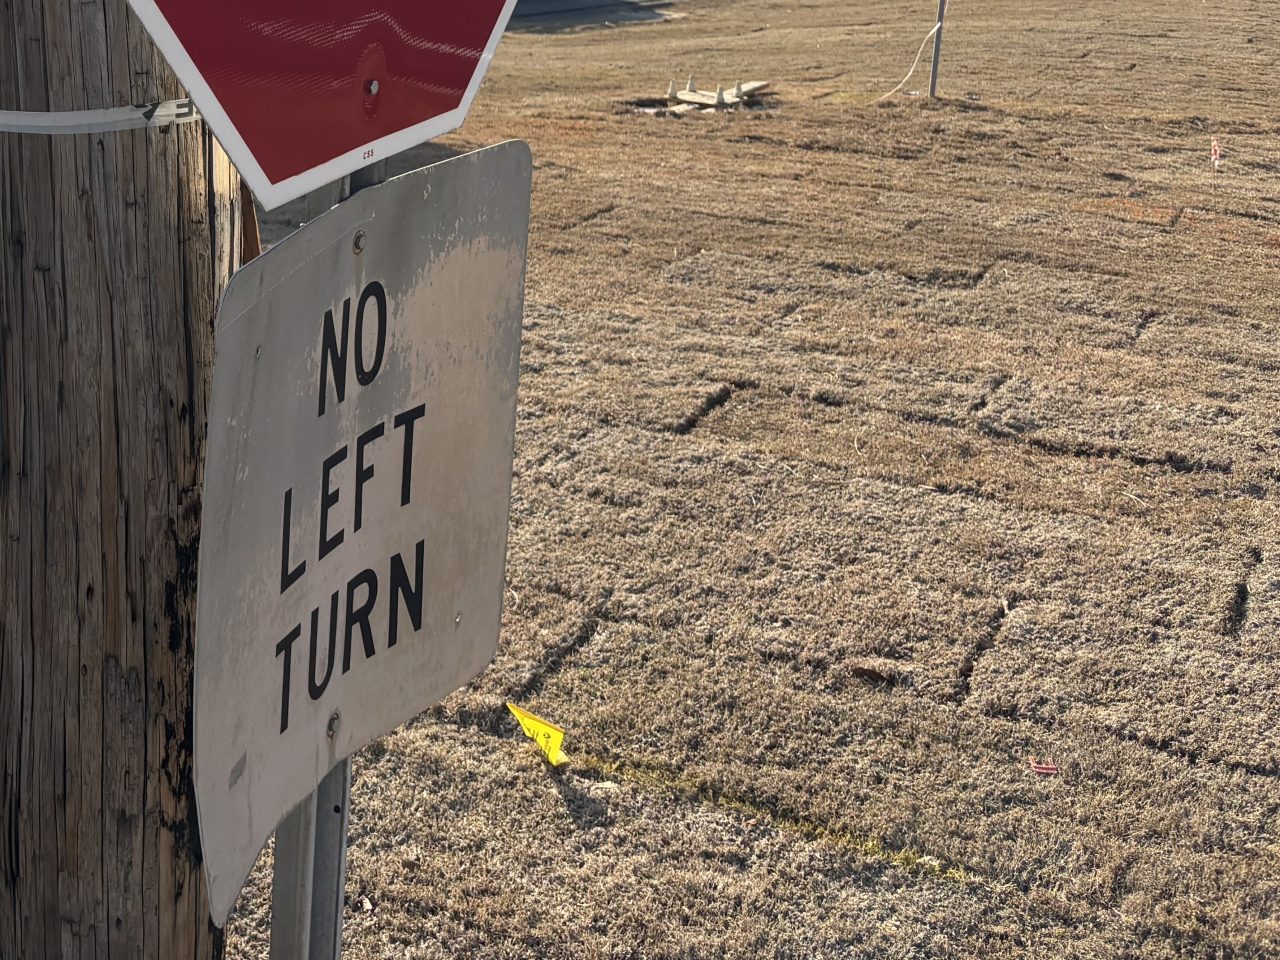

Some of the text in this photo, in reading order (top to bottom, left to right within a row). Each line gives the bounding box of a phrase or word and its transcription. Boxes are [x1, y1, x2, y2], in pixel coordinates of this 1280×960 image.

[317, 280, 388, 418] NO
[279, 402, 427, 596] LEFT
[274, 538, 426, 735] TURN
